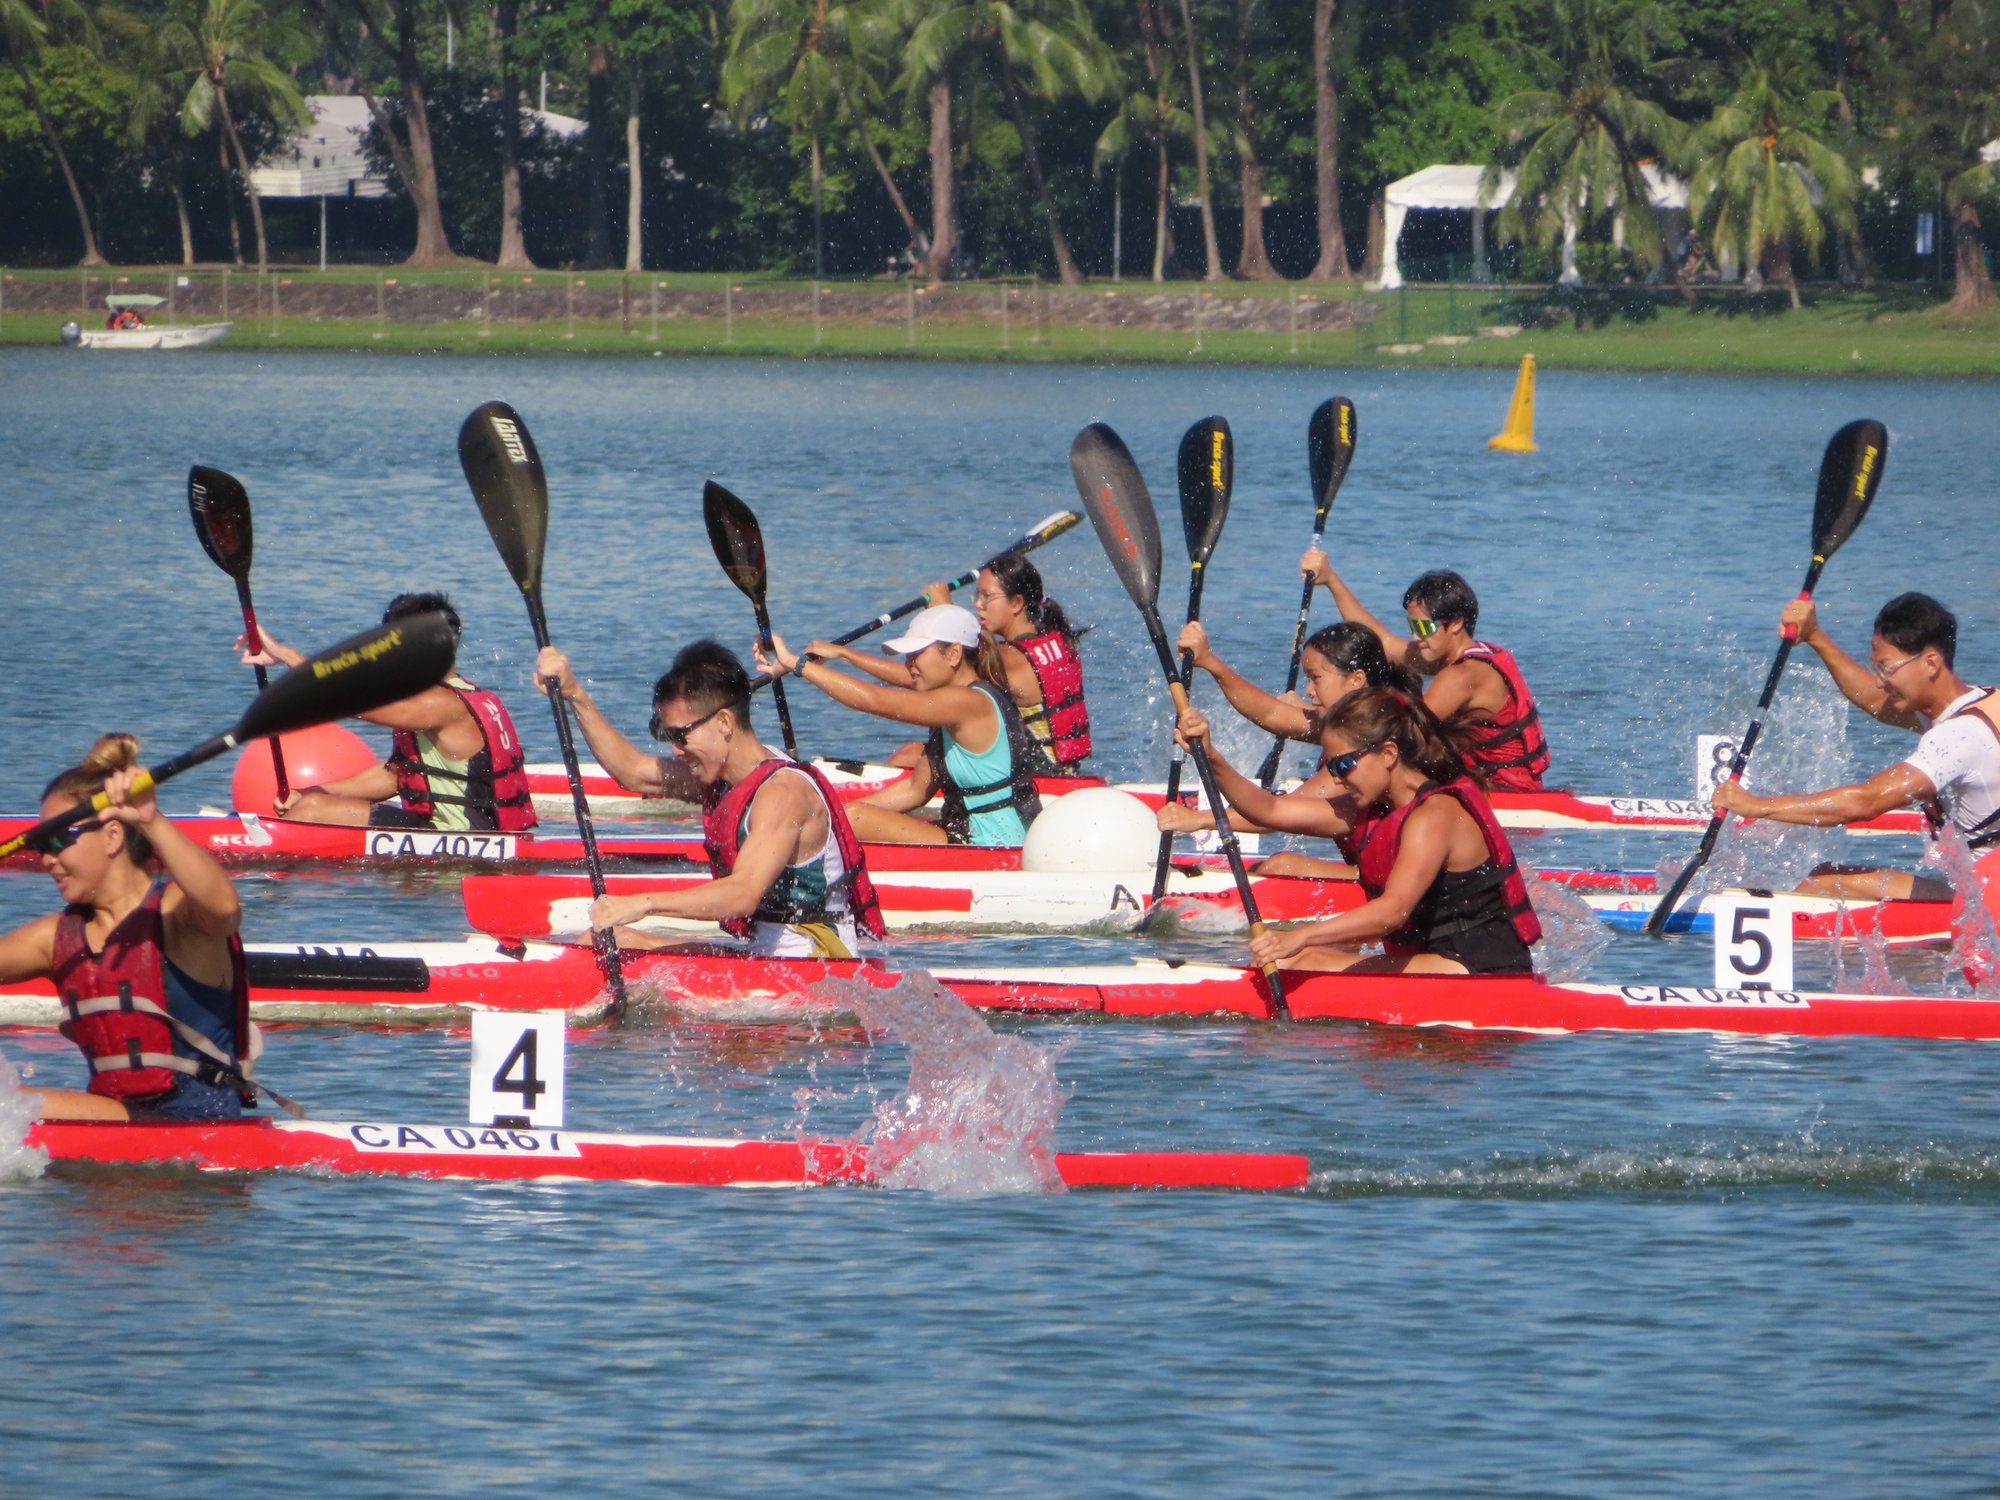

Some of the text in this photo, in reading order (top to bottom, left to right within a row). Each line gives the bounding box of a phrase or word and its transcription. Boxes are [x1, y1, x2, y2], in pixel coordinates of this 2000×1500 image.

[482, 698, 510, 750] NTU
[1610, 799, 1660, 814] CA
[371, 833, 507, 859] CA 4071
[1729, 907, 1773, 976] 5
[1620, 985, 1691, 1003] CA
[492, 1028, 546, 1110] 4
[350, 1125, 437, 1148] CA
